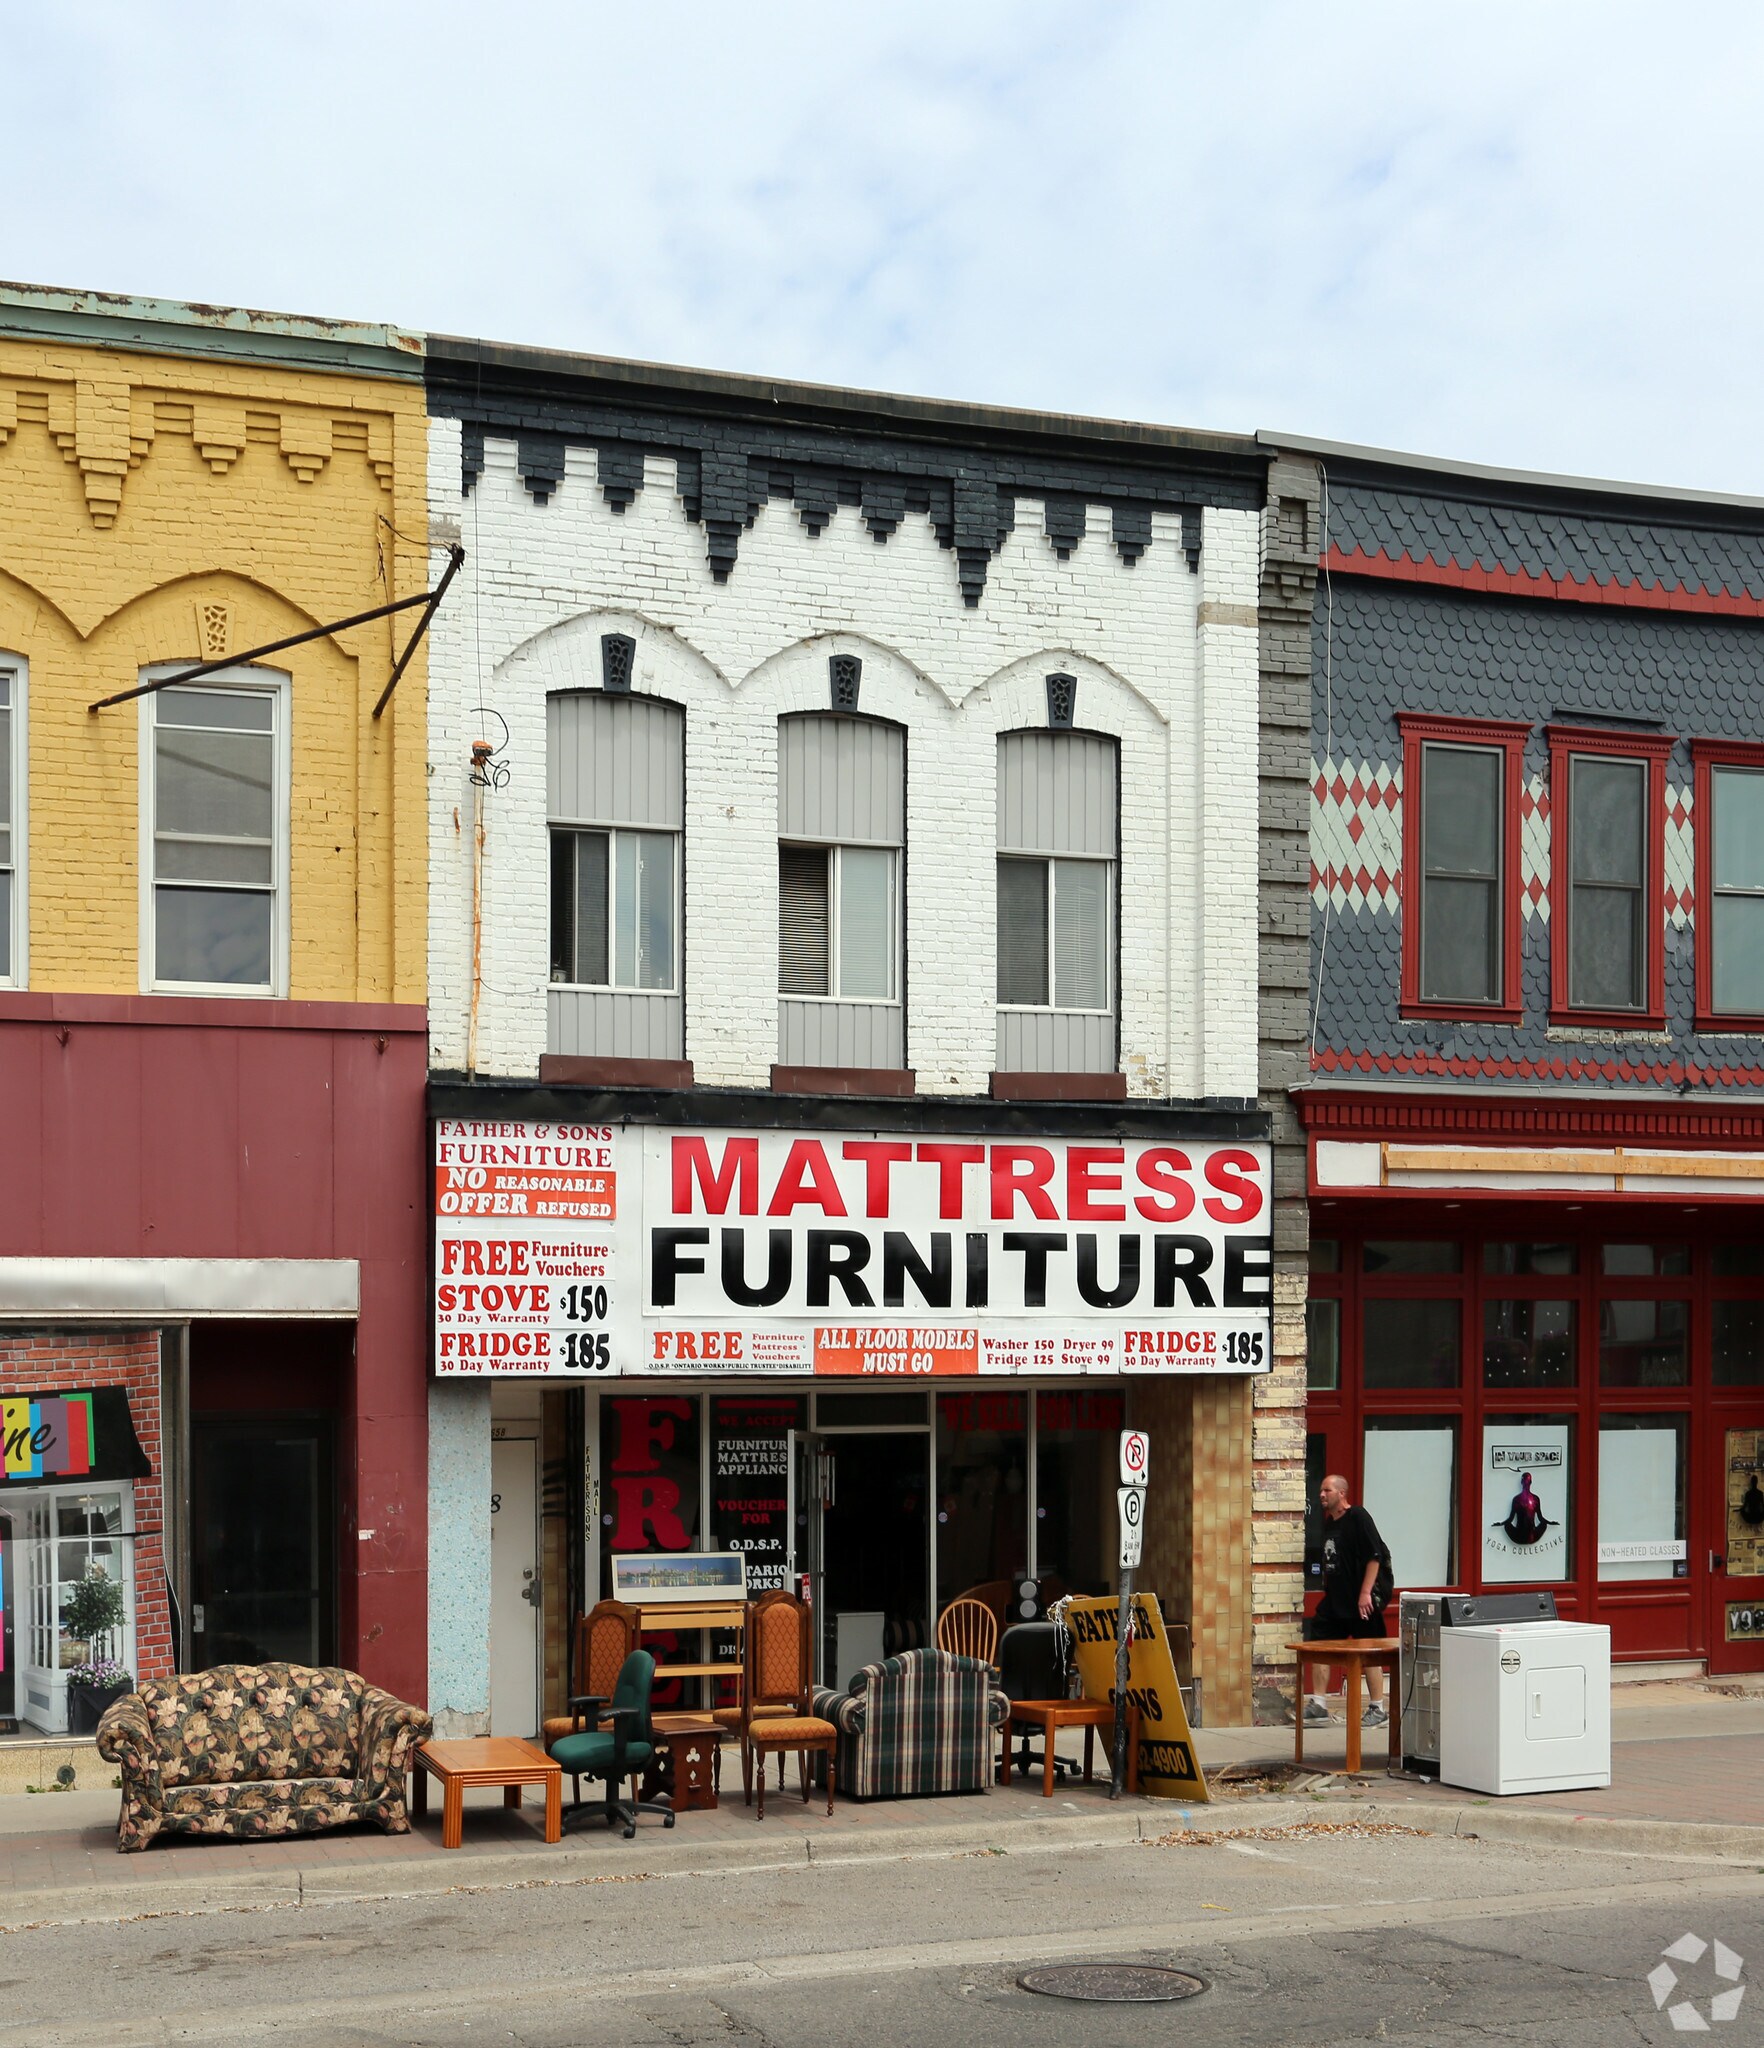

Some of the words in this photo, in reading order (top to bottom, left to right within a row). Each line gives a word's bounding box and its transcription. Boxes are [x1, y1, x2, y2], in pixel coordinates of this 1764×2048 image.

[440, 1121, 526, 1139] FATHER
[534, 1124, 550, 1139] &
[557, 1126, 612, 1141] SONS
[439, 1143, 612, 1167] FURNITURE
[446, 1167, 487, 1189] NO
[495, 1176, 605, 1192] REASONABLE
[671, 1136, 1263, 1224] MATTRESS
[439, 1192, 528, 1214] OFFER
[536, 1202, 611, 1217] REFUSED
[441, 1240, 530, 1276] FREE
[532, 1241, 609, 1257] Furniture
[535, 1261, 605, 1277] Vouchers
[651, 1227, 1271, 1308] FURNITURE
[438, 1285, 550, 1312] STOVE
[559, 1285, 608, 1323] $150
[437, 1314, 451, 1323] 30
[458, 1314, 482, 1325] Day
[488, 1313, 550, 1324] Warranty
[653, 1331, 743, 1359] FREE
[752, 1333, 805, 1341] Furniture
[818, 1329, 850, 1349] ALL
[855, 1329, 908, 1350] FLOOR
[911, 1330, 975, 1350] MODELS
[982, 1338, 1028, 1350] Washer
[1034, 1339, 1054, 1350] 150
[1063, 1338, 1096, 1352] Dryer
[1101, 1339, 1114, 1351] 99
[440, 1333, 551, 1356] FRIDGE
[559, 1333, 610, 1370] $185
[752, 1343, 798, 1351] Mattress
[1124, 1331, 1217, 1353] FRIDGE
[1222, 1331, 1263, 1366] $185
[440, 1361, 454, 1371] 30
[460, 1360, 483, 1373] Day
[489, 1359, 550, 1372] Warranty
[752, 1353, 801, 1361] Vouchers
[862, 1353, 907, 1373] MUST
[911, 1352, 933, 1373] GO
[986, 1353, 1028, 1367] Fridge
[1033, 1354, 1054, 1364] 125
[1061, 1353, 1092, 1365] Stove
[1097, 1354, 1110, 1365] 99
[1124, 1356, 1136, 1366] 30
[1140, 1355, 1160, 1368] Day
[1165, 1355, 1217, 1368] Warranty
[741, 1513, 771, 1524] FOR
[729, 1539, 782, 1550] O.D.S.P.
[1486, 1537, 1507, 1552] YOGA
[1512, 1536, 1563, 1555] COLLECTIVE
[1601, 1546, 1646, 1557] NON-HEATED
[1650, 1545, 1680, 1555] CLASSES
